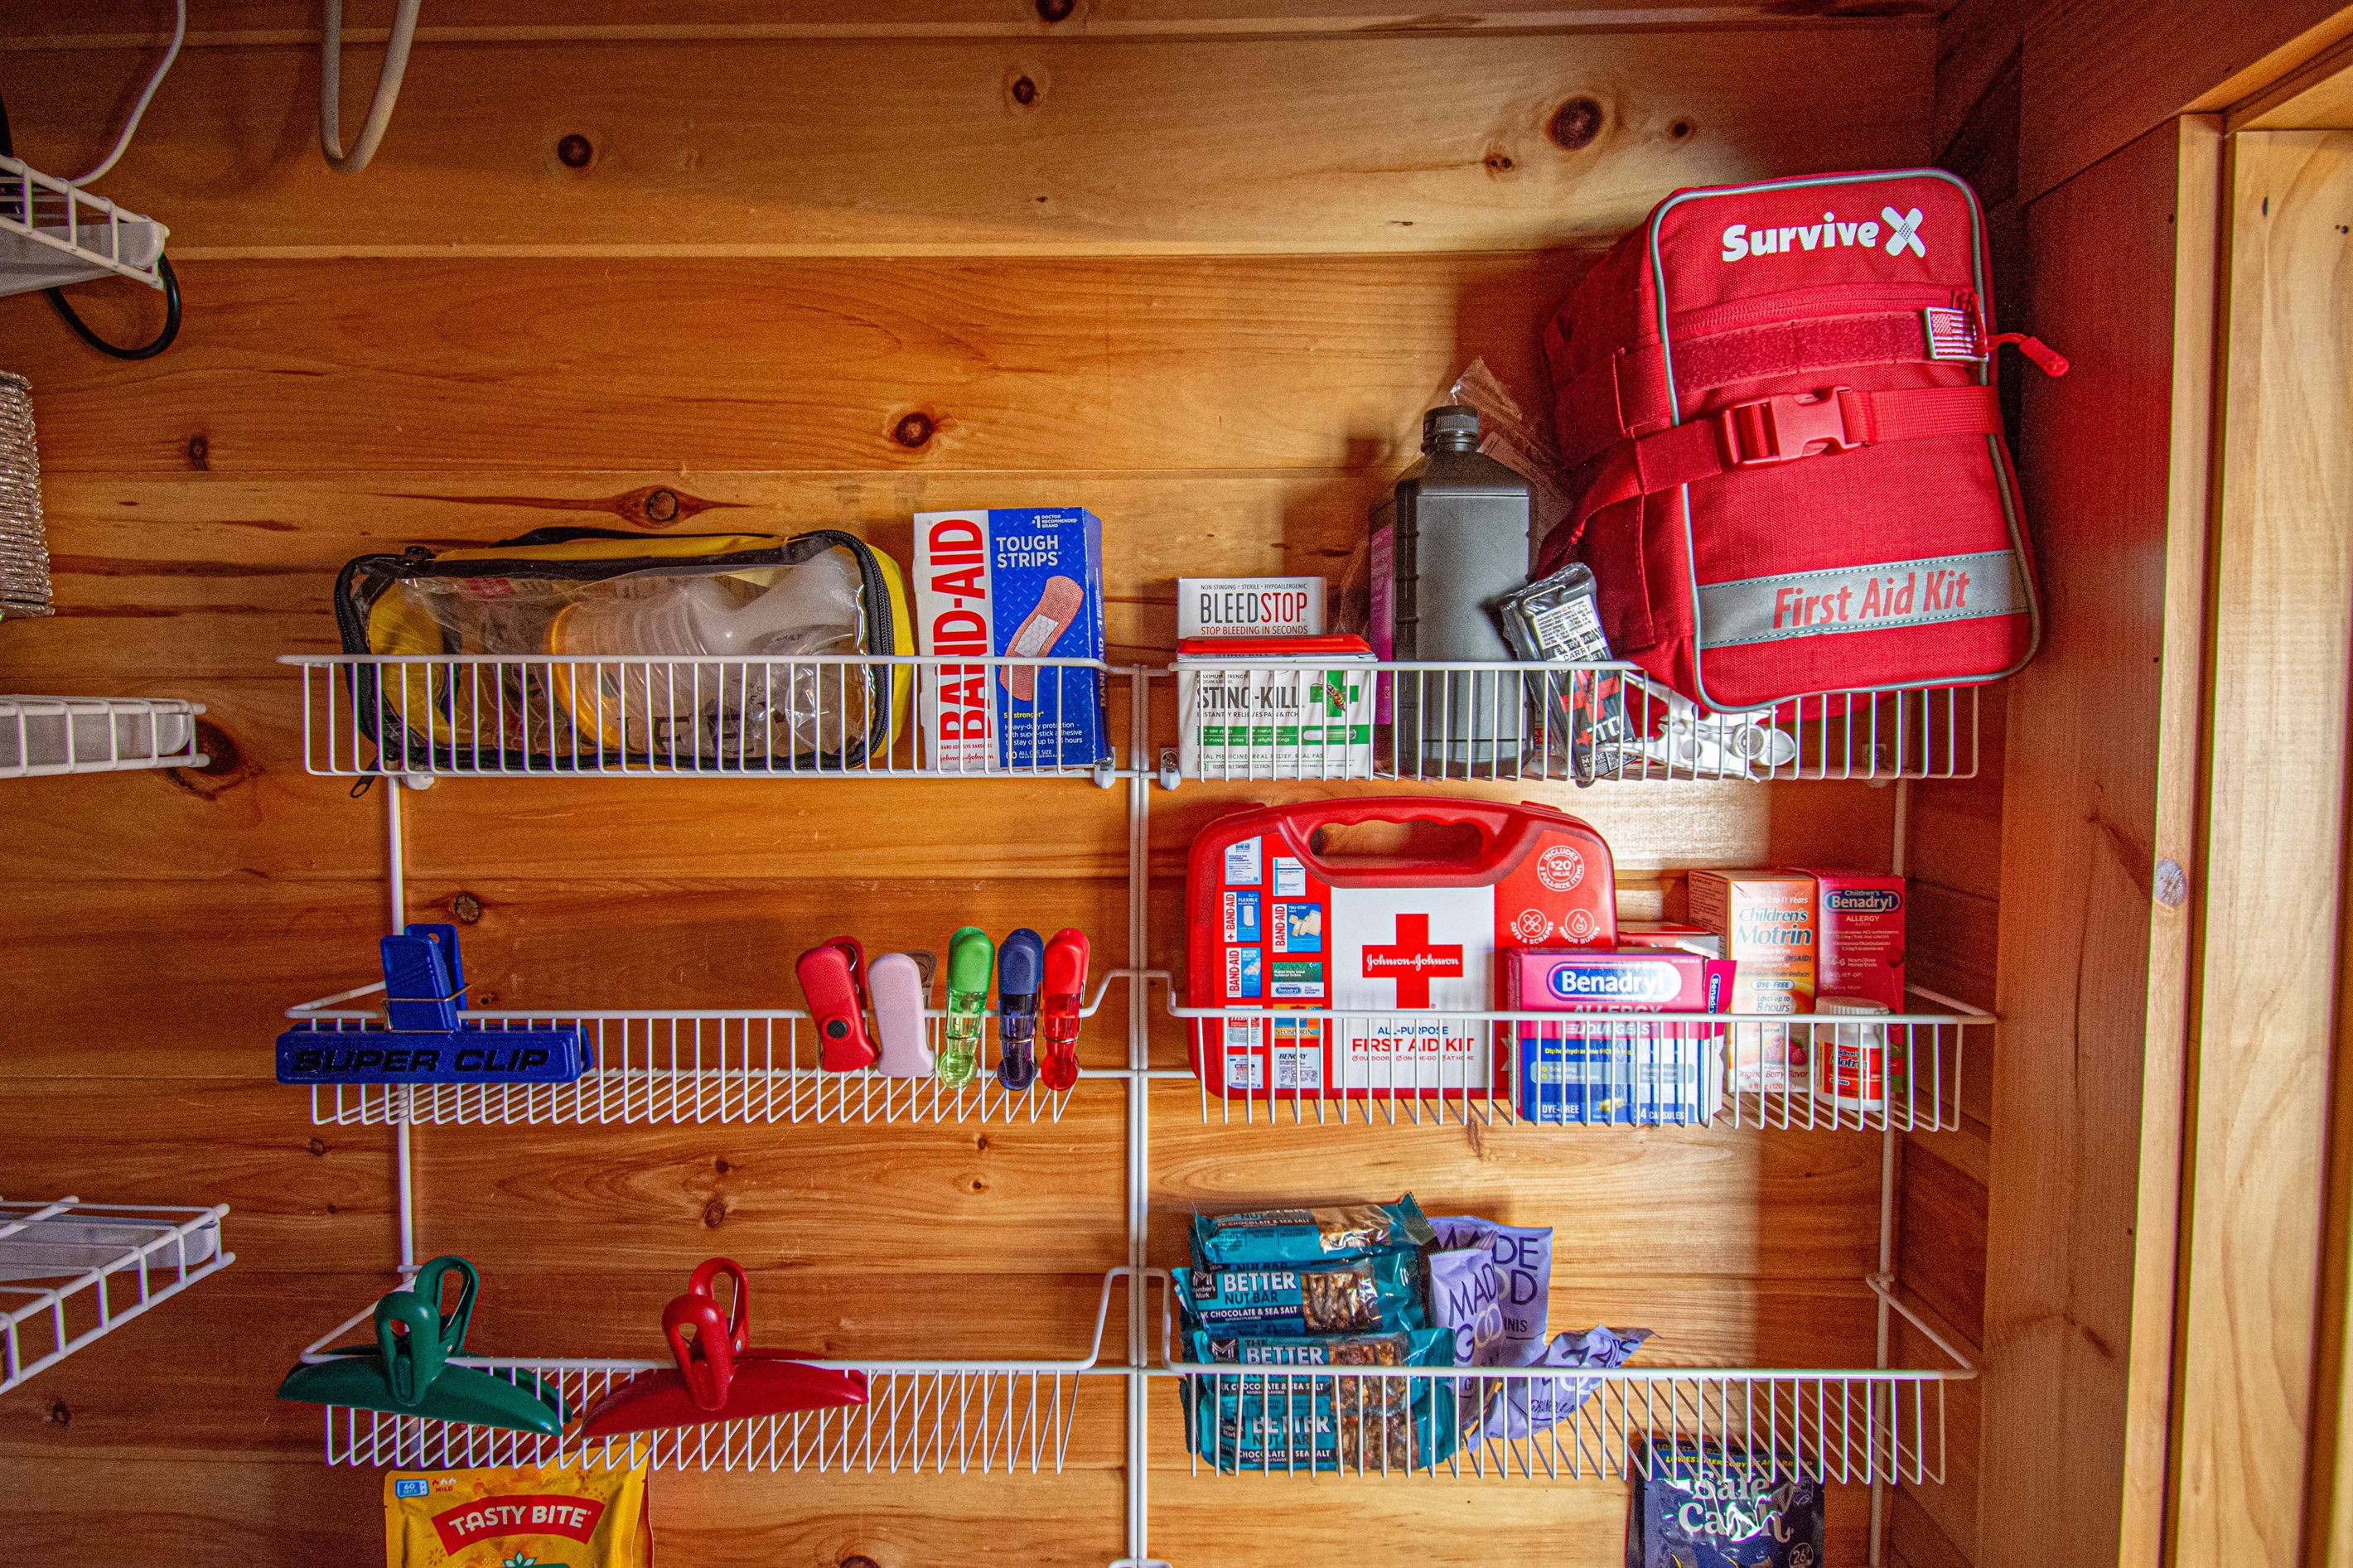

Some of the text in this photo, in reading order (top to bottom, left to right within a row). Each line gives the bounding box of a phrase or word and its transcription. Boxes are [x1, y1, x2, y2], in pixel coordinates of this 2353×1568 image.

[996, 534, 1059, 552] TOUGH
[997, 551, 1058, 568] STRIPS
[1201, 592, 1307, 624] BLEEDSTOP
[1773, 570, 1971, 630] First Aid Kit
[1201, 625, 1308, 634] STOP BLEEDING IN SECONDS
[1543, 847, 1579, 861] INCLUDES
[1551, 860, 1572, 871] $20
[1541, 871, 1571, 889] FULL-SIZE
[1572, 865, 1582, 885] ITEMS
[1226, 894, 1235, 929] BAND-AID
[1832, 895, 1892, 912] Benadryl
[1738, 907, 1808, 922] Children's
[1275, 906, 1286, 946] BAND-AID
[1511, 921, 1523, 940] CUTS
[1529, 921, 1554, 944] SCRAPES
[1559, 926, 1601, 944] MINOR BURNS
[1735, 924, 1811, 944] Motrin
[1230, 950, 1239, 991] BAND-AID
[1756, 1002, 1790, 1012] 8 hours
[1352, 1038, 1475, 1052] FIRST AID KIT
[294, 1049, 550, 1073] SUPER CLIP
[1766, 1070, 1785, 1079] Berry
[1223, 1272, 1297, 1293] BETTER
[1225, 1292, 1279, 1305] NUT BAR
[1448, 1262, 1498, 1327] MAD
[1210, 1309, 1255, 1319] CHOCOLATE
[1265, 1307, 1279, 1315] SEA
[1281, 1305, 1297, 1315] SALT
[1246, 1346, 1325, 1365] BETTER
[448, 1505, 585, 1537] TASTY BITE
